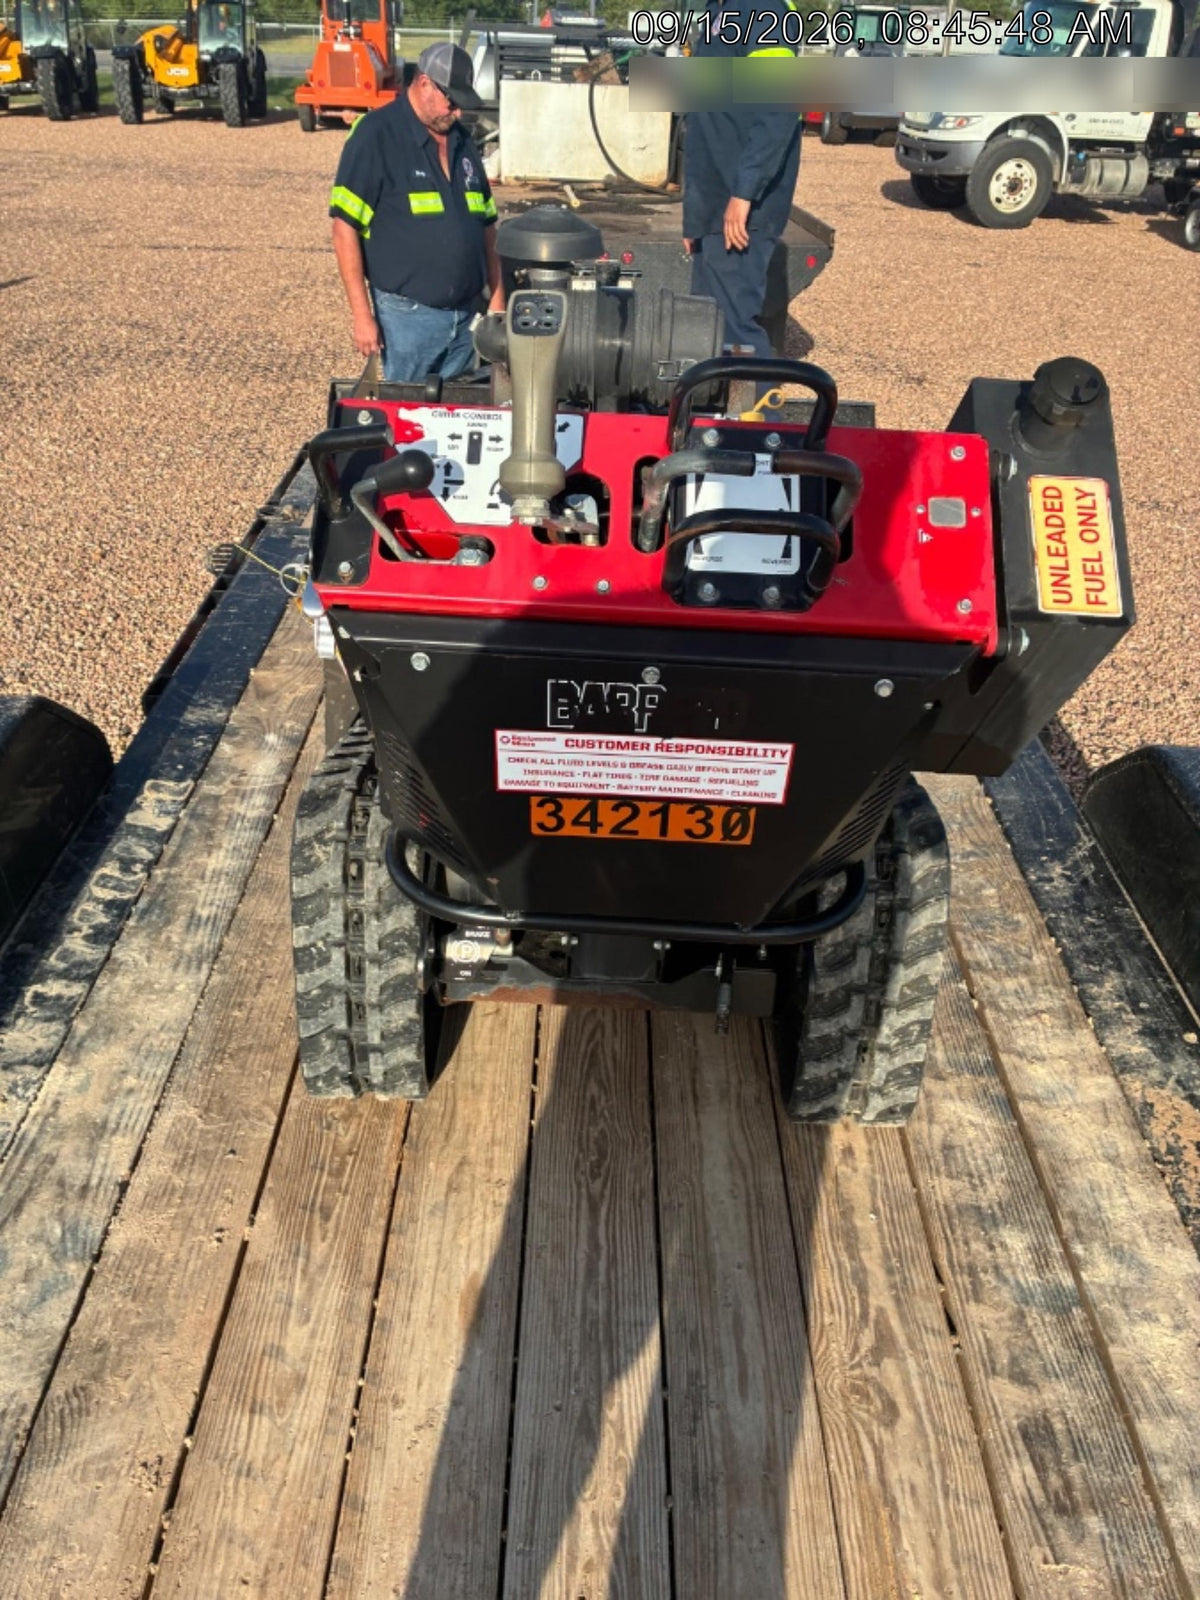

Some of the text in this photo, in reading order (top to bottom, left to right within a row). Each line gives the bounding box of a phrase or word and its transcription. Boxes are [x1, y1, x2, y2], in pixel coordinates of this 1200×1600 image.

[1042, 485, 1073, 605] UNLEADED
[1074, 487, 1108, 606] FUEL ONLY
[564, 738, 788, 759] CUSTOMER RESPONSIBILITY
[523, 768, 760, 787] INSURANCE FLAT TIRES TIRE DAMAGE REFUELING
[557, 758, 584, 767] FLUID
[586, 760, 619, 769] LEVELS
[629, 762, 664, 771] GREASE
[666, 763, 693, 772] DAILY
[694, 765, 730, 774] BEFORE
[731, 767, 761, 776] START
[504, 778, 778, 799] DAMAGE TO EQUIPMENT BATTERY MAINTENANCE CLEANING
[535, 798, 751, 842] 342130
[465, 929, 491, 939] BRAKE
[459, 969, 472, 977] ON
